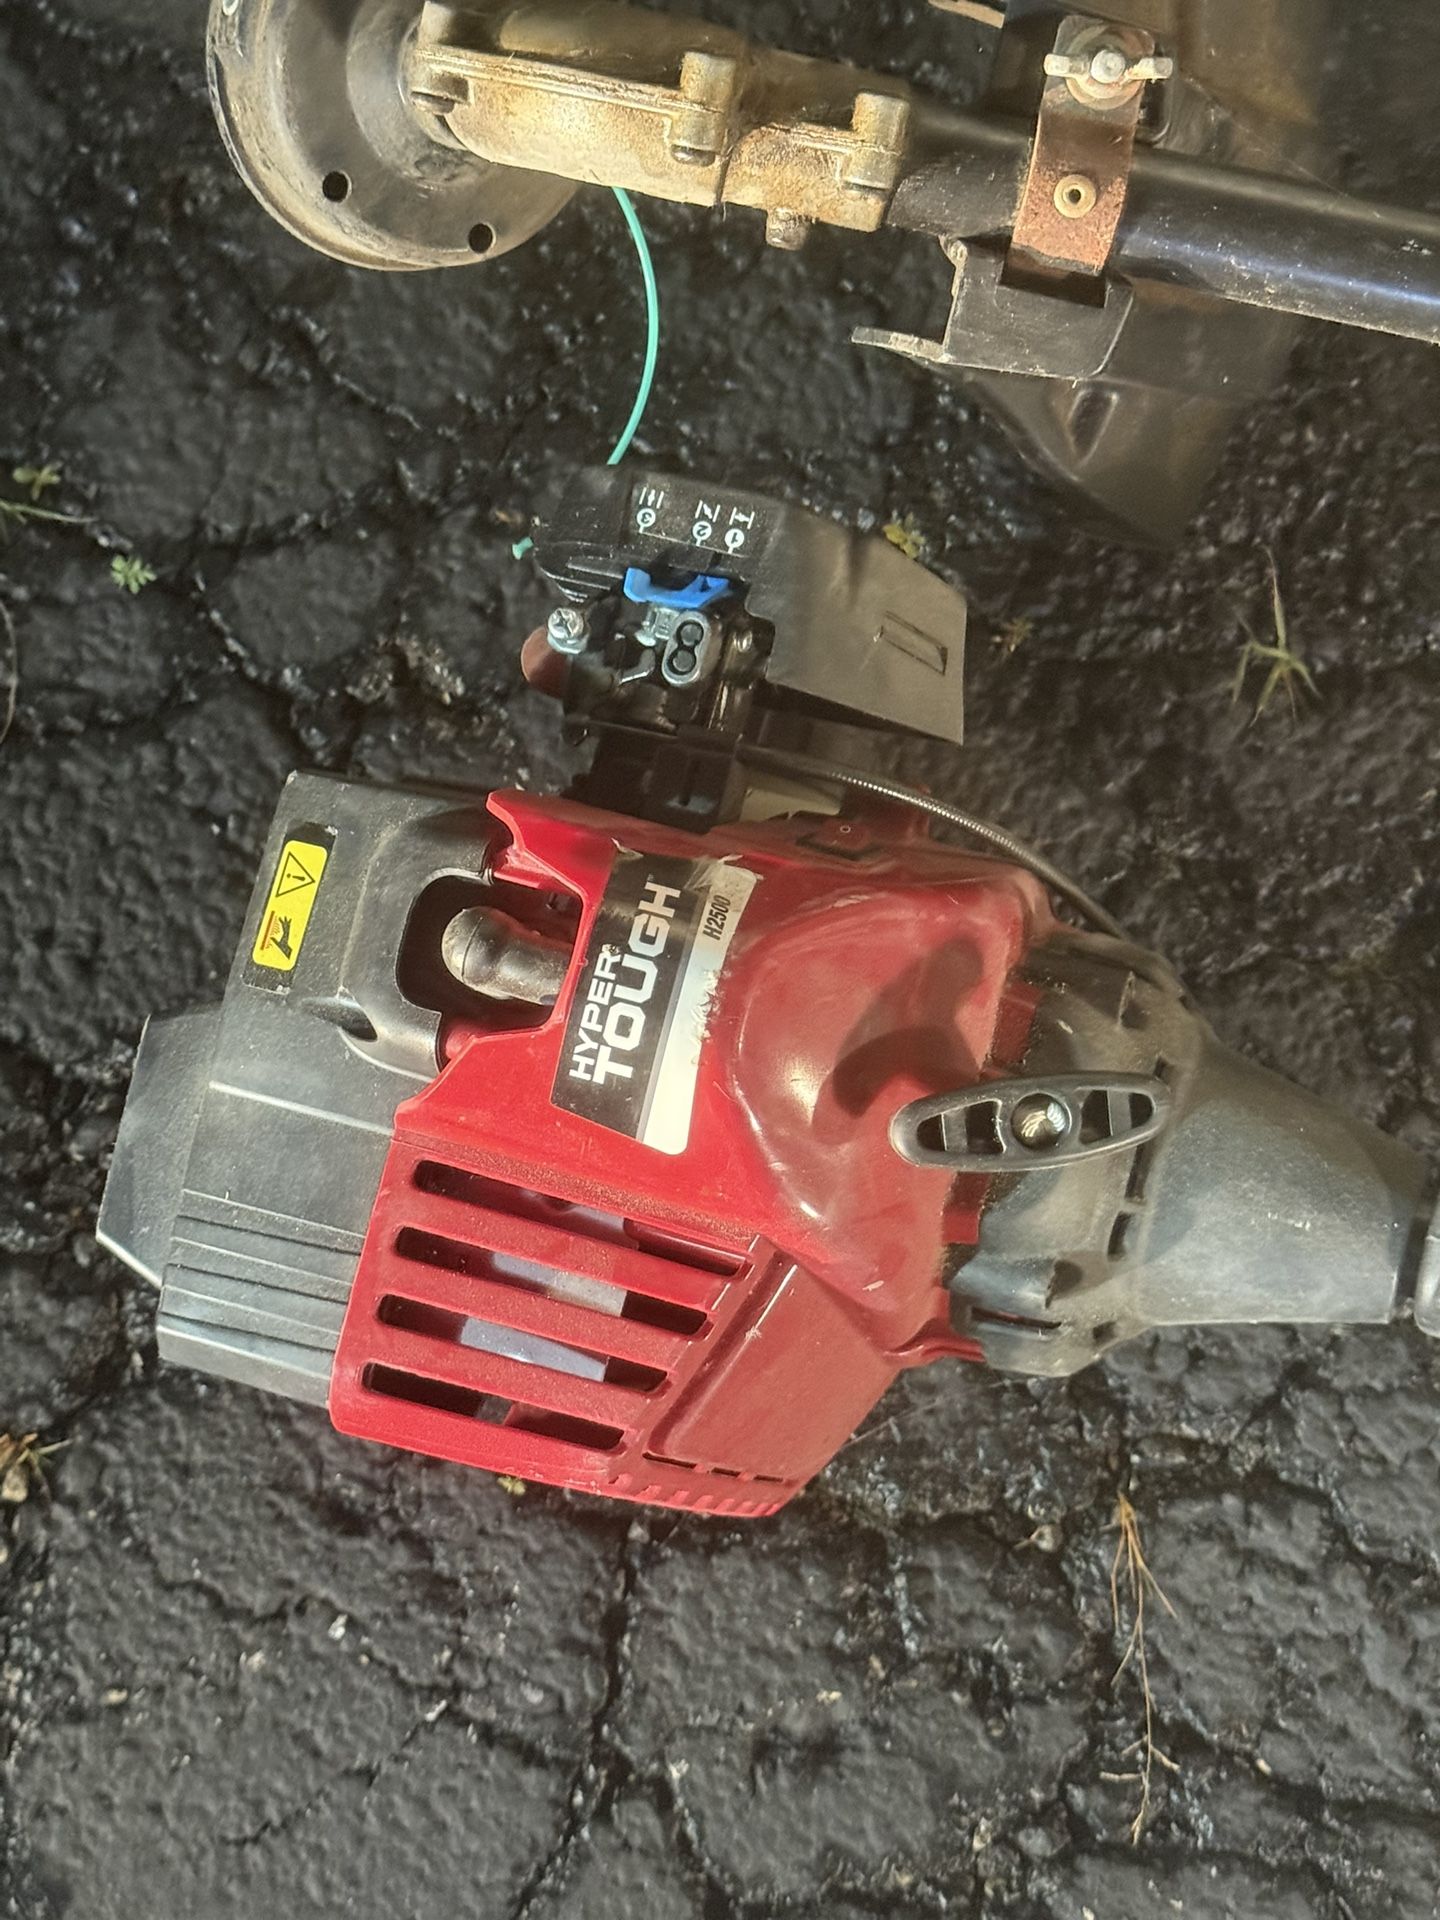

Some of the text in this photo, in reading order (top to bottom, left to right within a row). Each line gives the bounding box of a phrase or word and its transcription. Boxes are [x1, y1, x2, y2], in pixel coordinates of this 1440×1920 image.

[592, 881, 681, 1084] TOUGH
[702, 894, 731, 941] H2500
[569, 946, 621, 1081] HYPER
